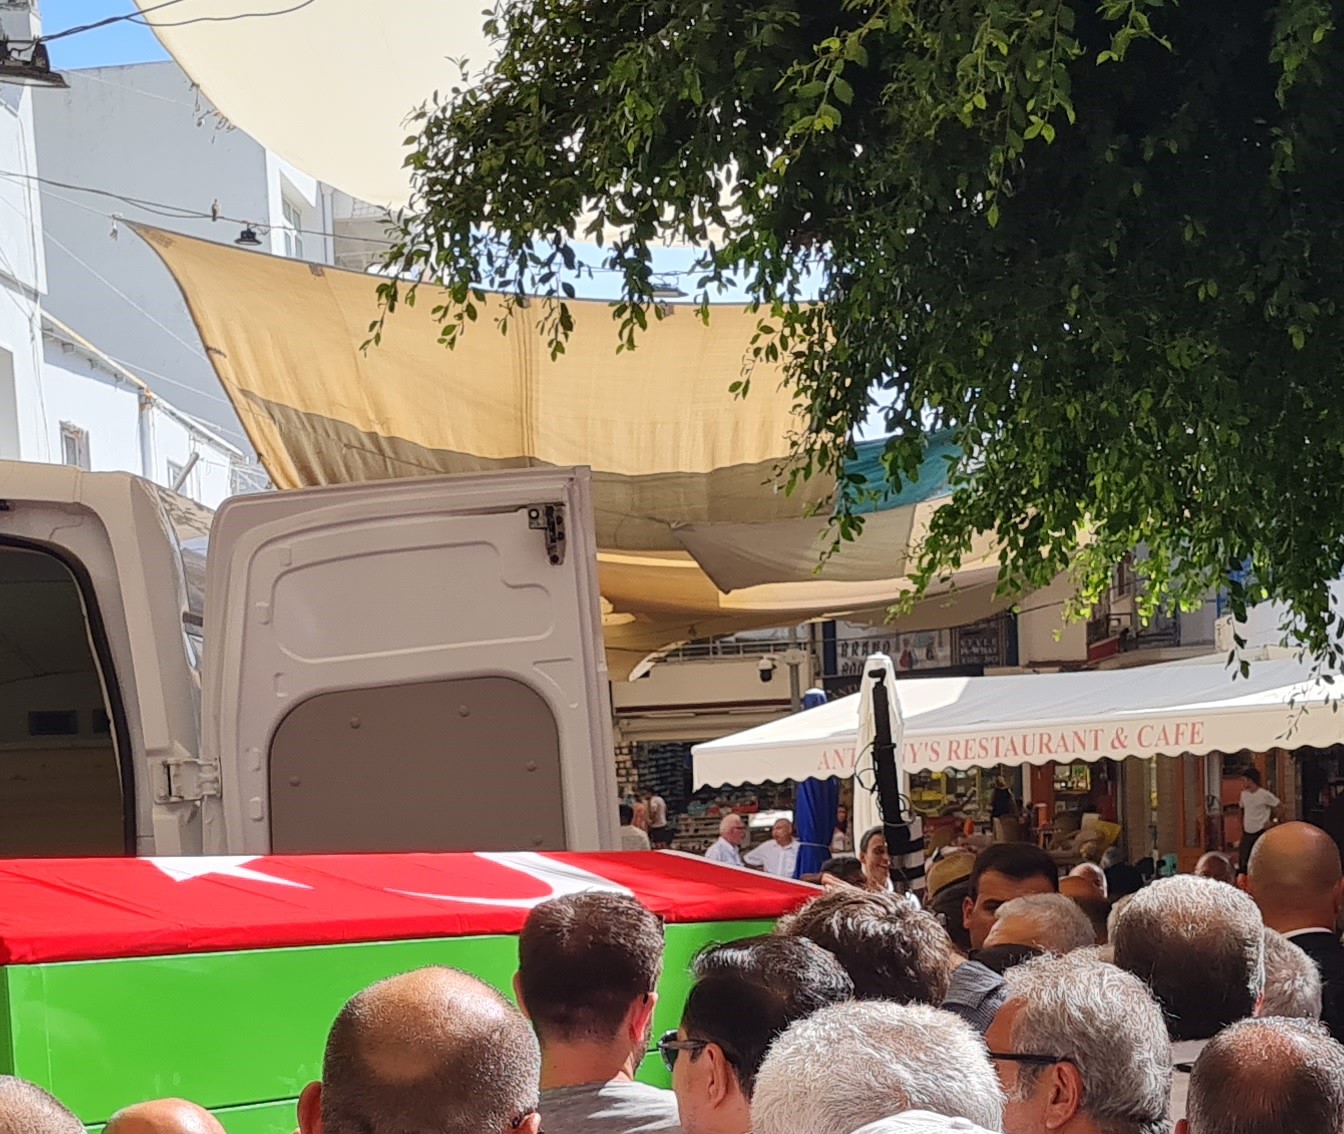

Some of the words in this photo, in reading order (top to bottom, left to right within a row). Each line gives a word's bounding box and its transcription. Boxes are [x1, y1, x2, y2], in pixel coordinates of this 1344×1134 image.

[947, 727, 1105, 762] RESTAURANT
[1110, 726, 1128, 750] &
[1137, 721, 1205, 748] CAFE
